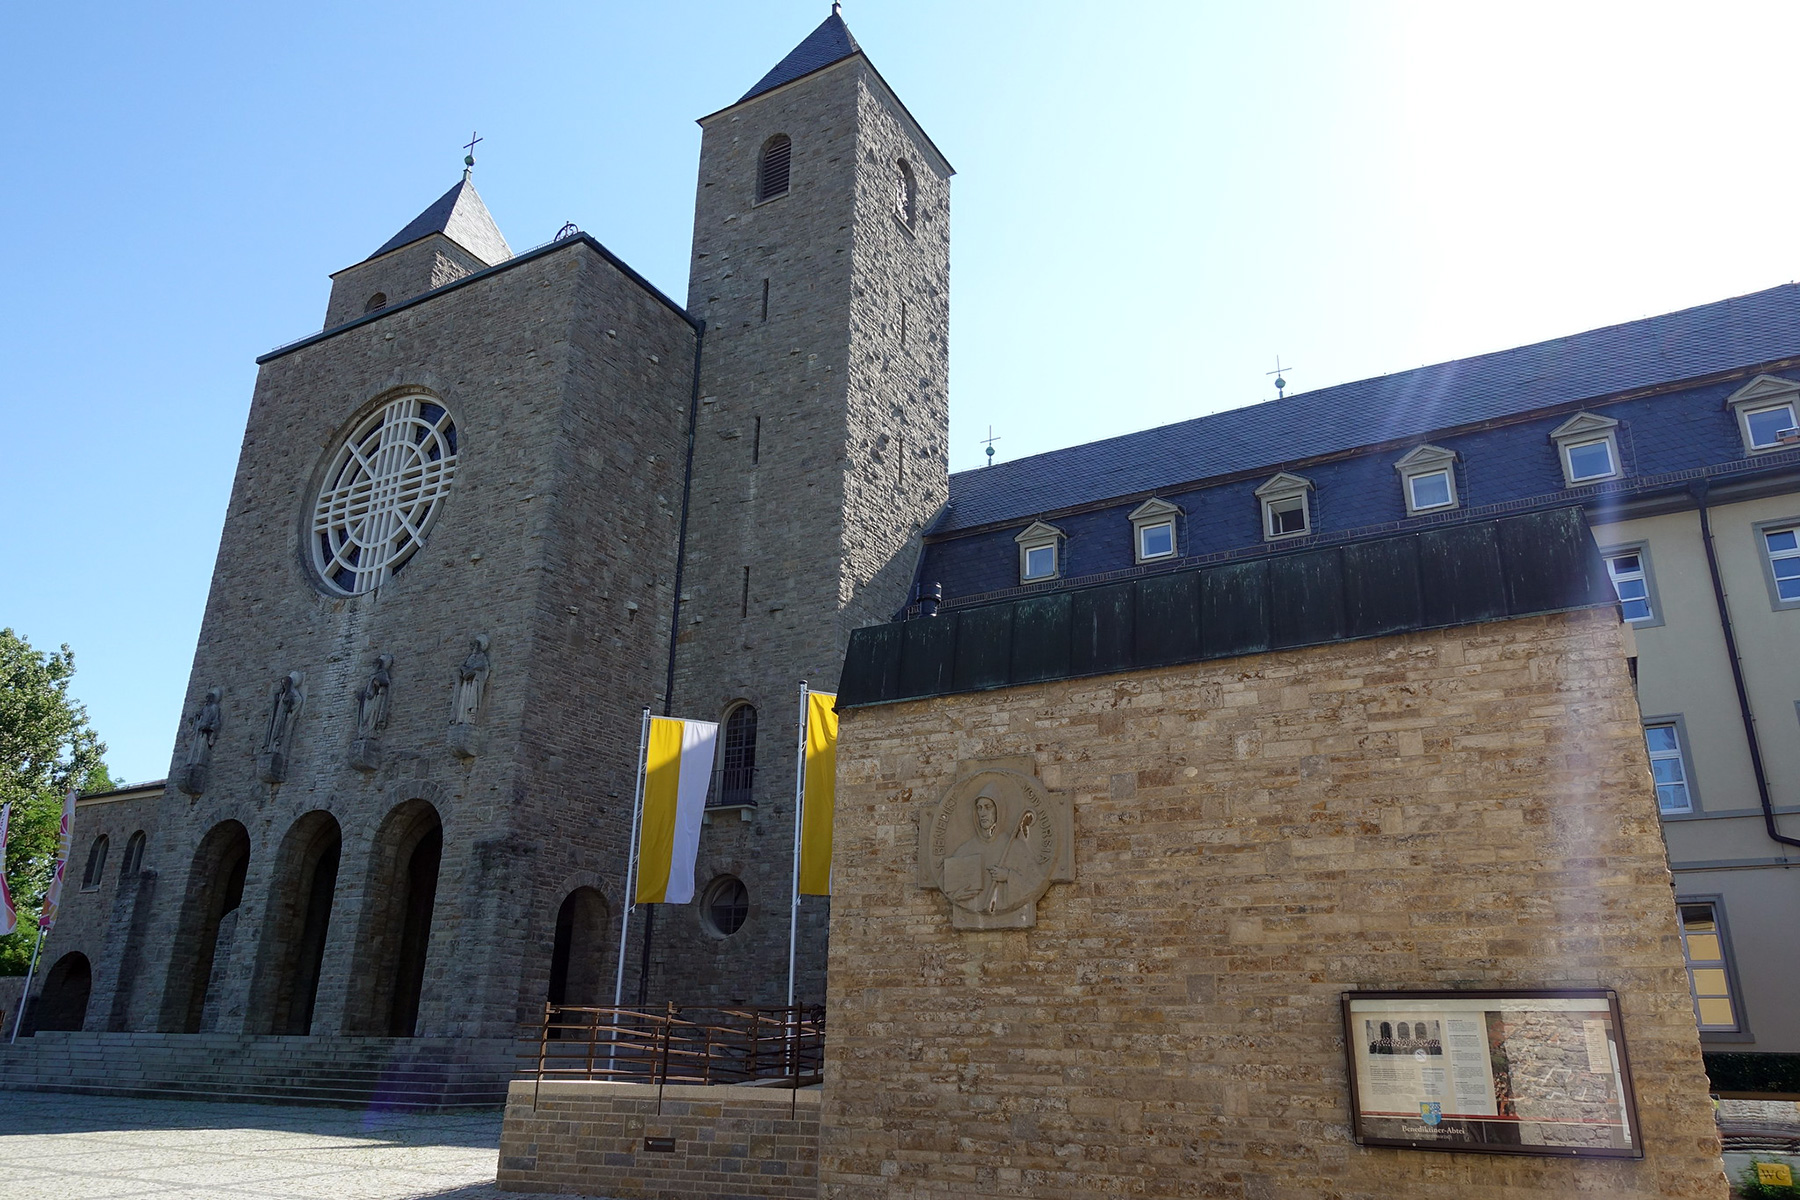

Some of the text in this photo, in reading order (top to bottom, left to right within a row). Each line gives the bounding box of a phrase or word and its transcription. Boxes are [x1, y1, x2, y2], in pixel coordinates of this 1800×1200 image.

[934, 792, 959, 857] BENEDIKT
[1023, 784, 1042, 807] VON
[1038, 810, 1053, 866] NURSIA
[1401, 1125, 1465, 1135] Benediktiner-Abtei
[1761, 1169, 1787, 1180] WC
